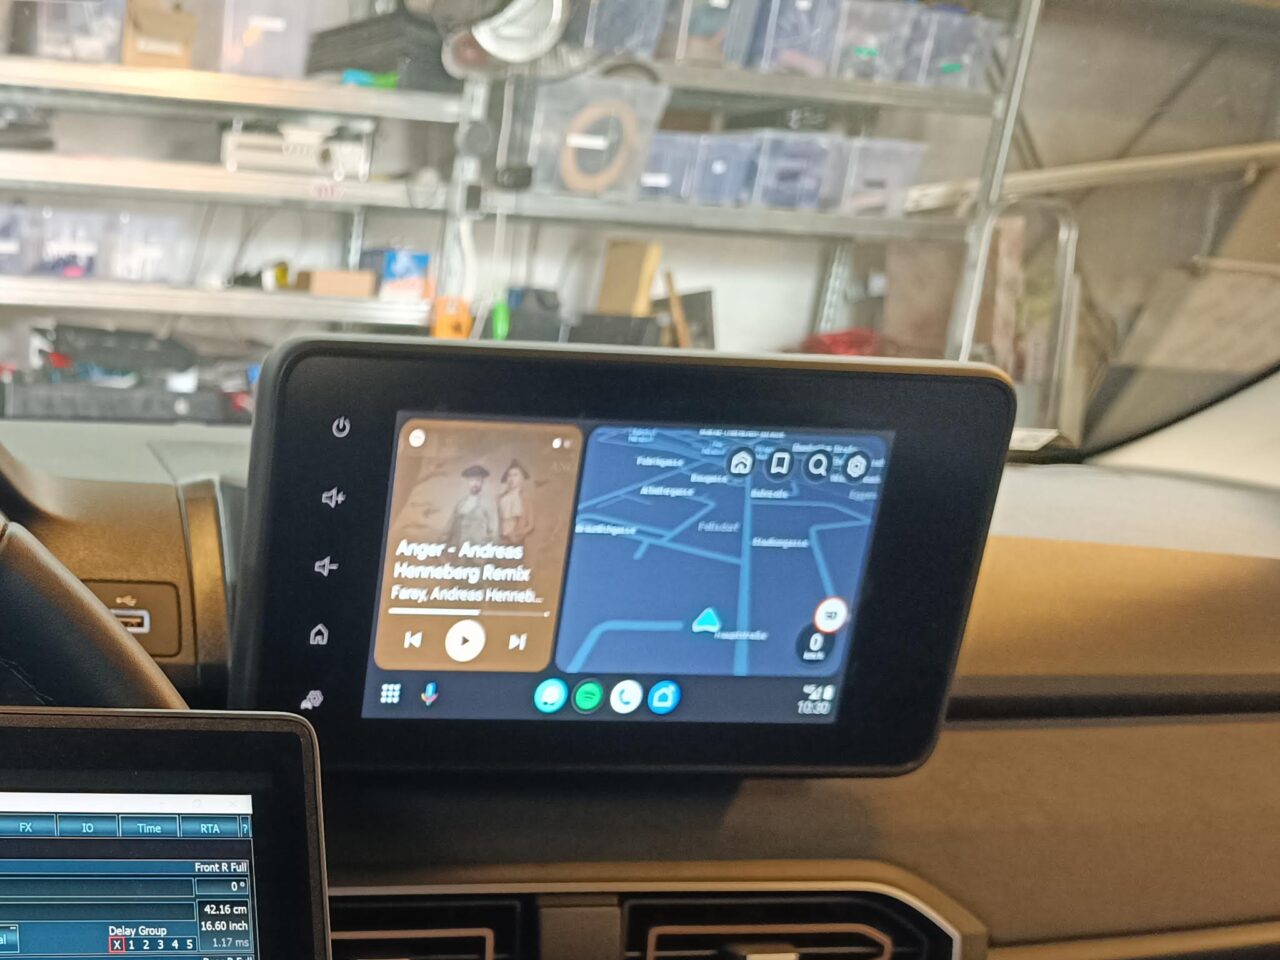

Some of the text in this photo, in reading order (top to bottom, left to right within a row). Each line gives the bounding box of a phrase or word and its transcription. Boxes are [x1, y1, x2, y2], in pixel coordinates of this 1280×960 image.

[395, 539, 447, 561] Anger
[458, 541, 524, 560] Andreas
[393, 561, 532, 584] Henneberg Remix
[429, 585, 484, 602] Andreas
[809, 632, 824, 651] 0
[20, 823, 32, 832] FX
[137, 824, 161, 833] Time
[200, 824, 220, 833] RTA
[195, 863, 247, 872] Front R Full
[204, 905, 247, 914] 42.16 cm
[201, 921, 248, 931] 16.60 inch
[109, 926, 167, 937] Delay Group
[213, 938, 249, 947] 1.17 ms
